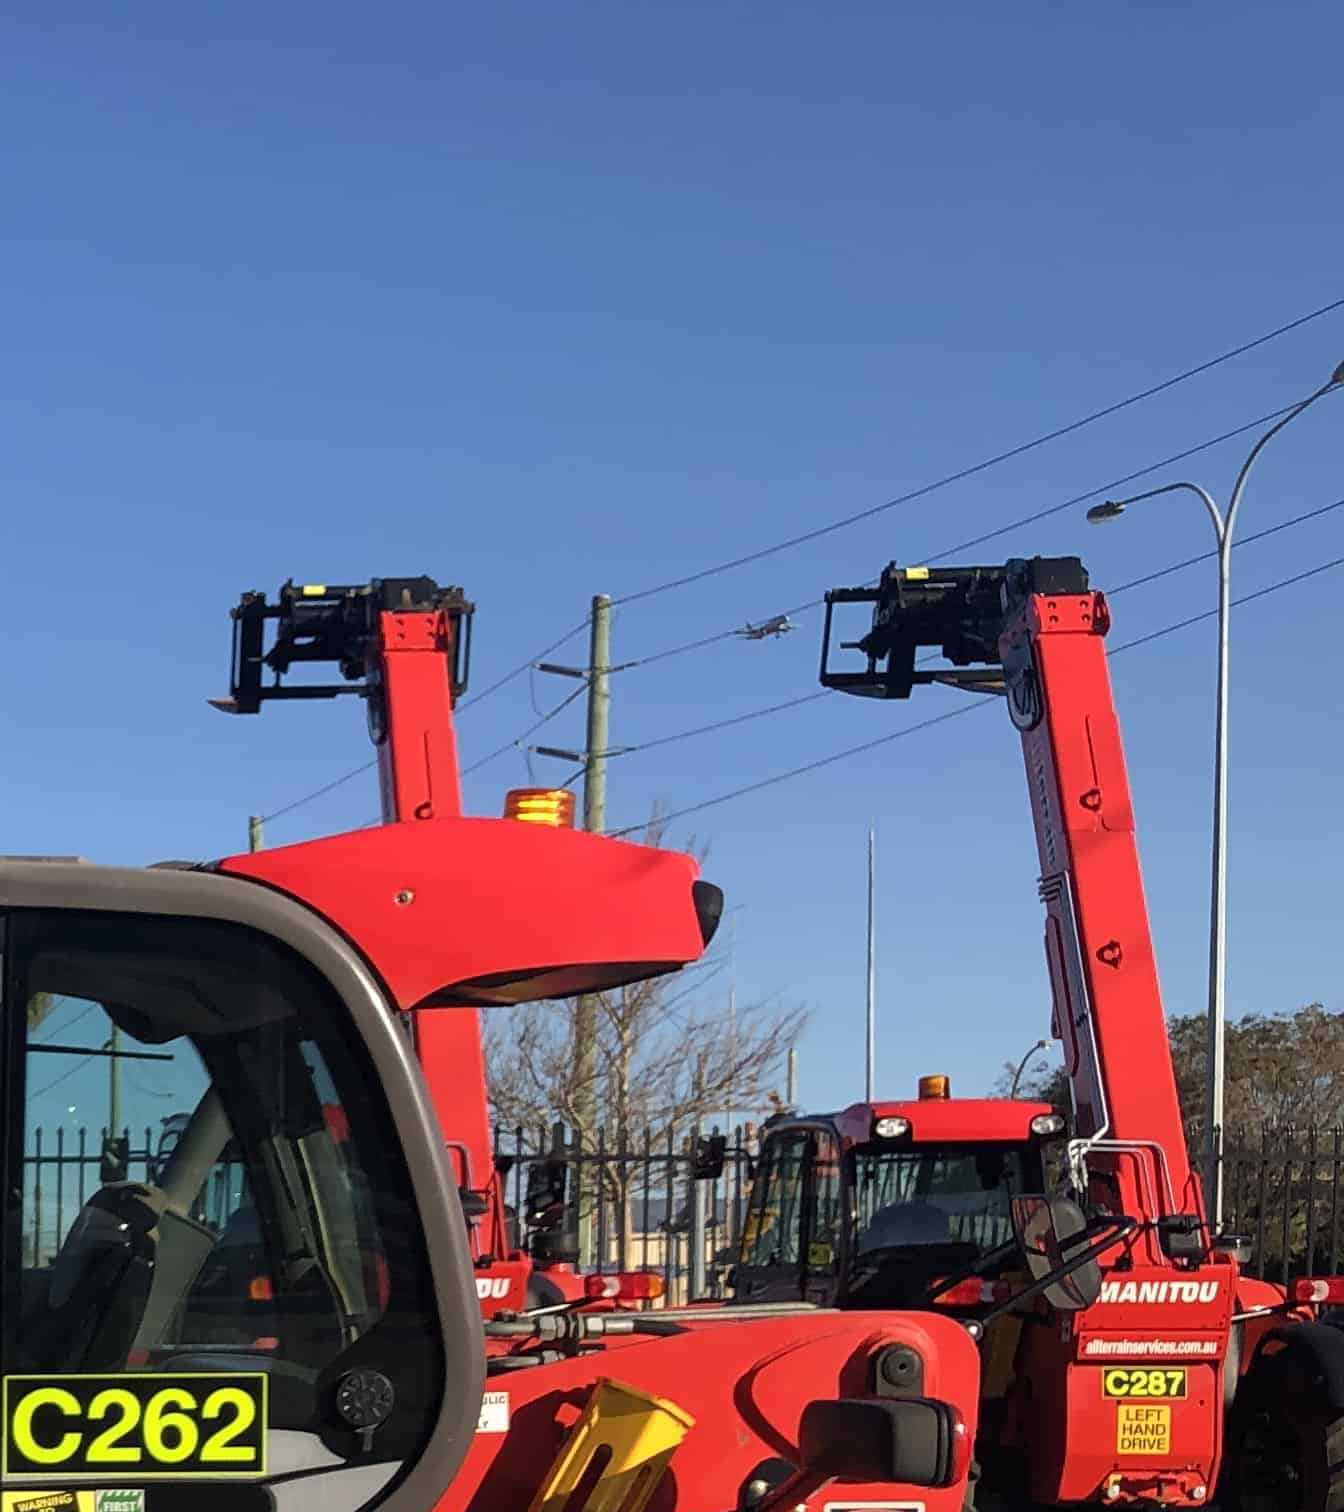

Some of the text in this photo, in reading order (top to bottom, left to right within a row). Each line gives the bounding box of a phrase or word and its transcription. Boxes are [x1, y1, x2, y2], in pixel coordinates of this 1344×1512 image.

[1096, 1281, 1219, 1303] MANITOU
[1086, 1338, 1217, 1355] allterrainservices.com.au
[1105, 1370, 1184, 1396] C287
[1125, 1409, 1162, 1421] LEFT
[13, 1387, 256, 1463] C262
[1122, 1424, 1166, 1436] HAND
[1120, 1438, 1167, 1451] DRIVE
[17, 1494, 74, 1512] WARNING
[103, 1502, 137, 1512] FIRST
